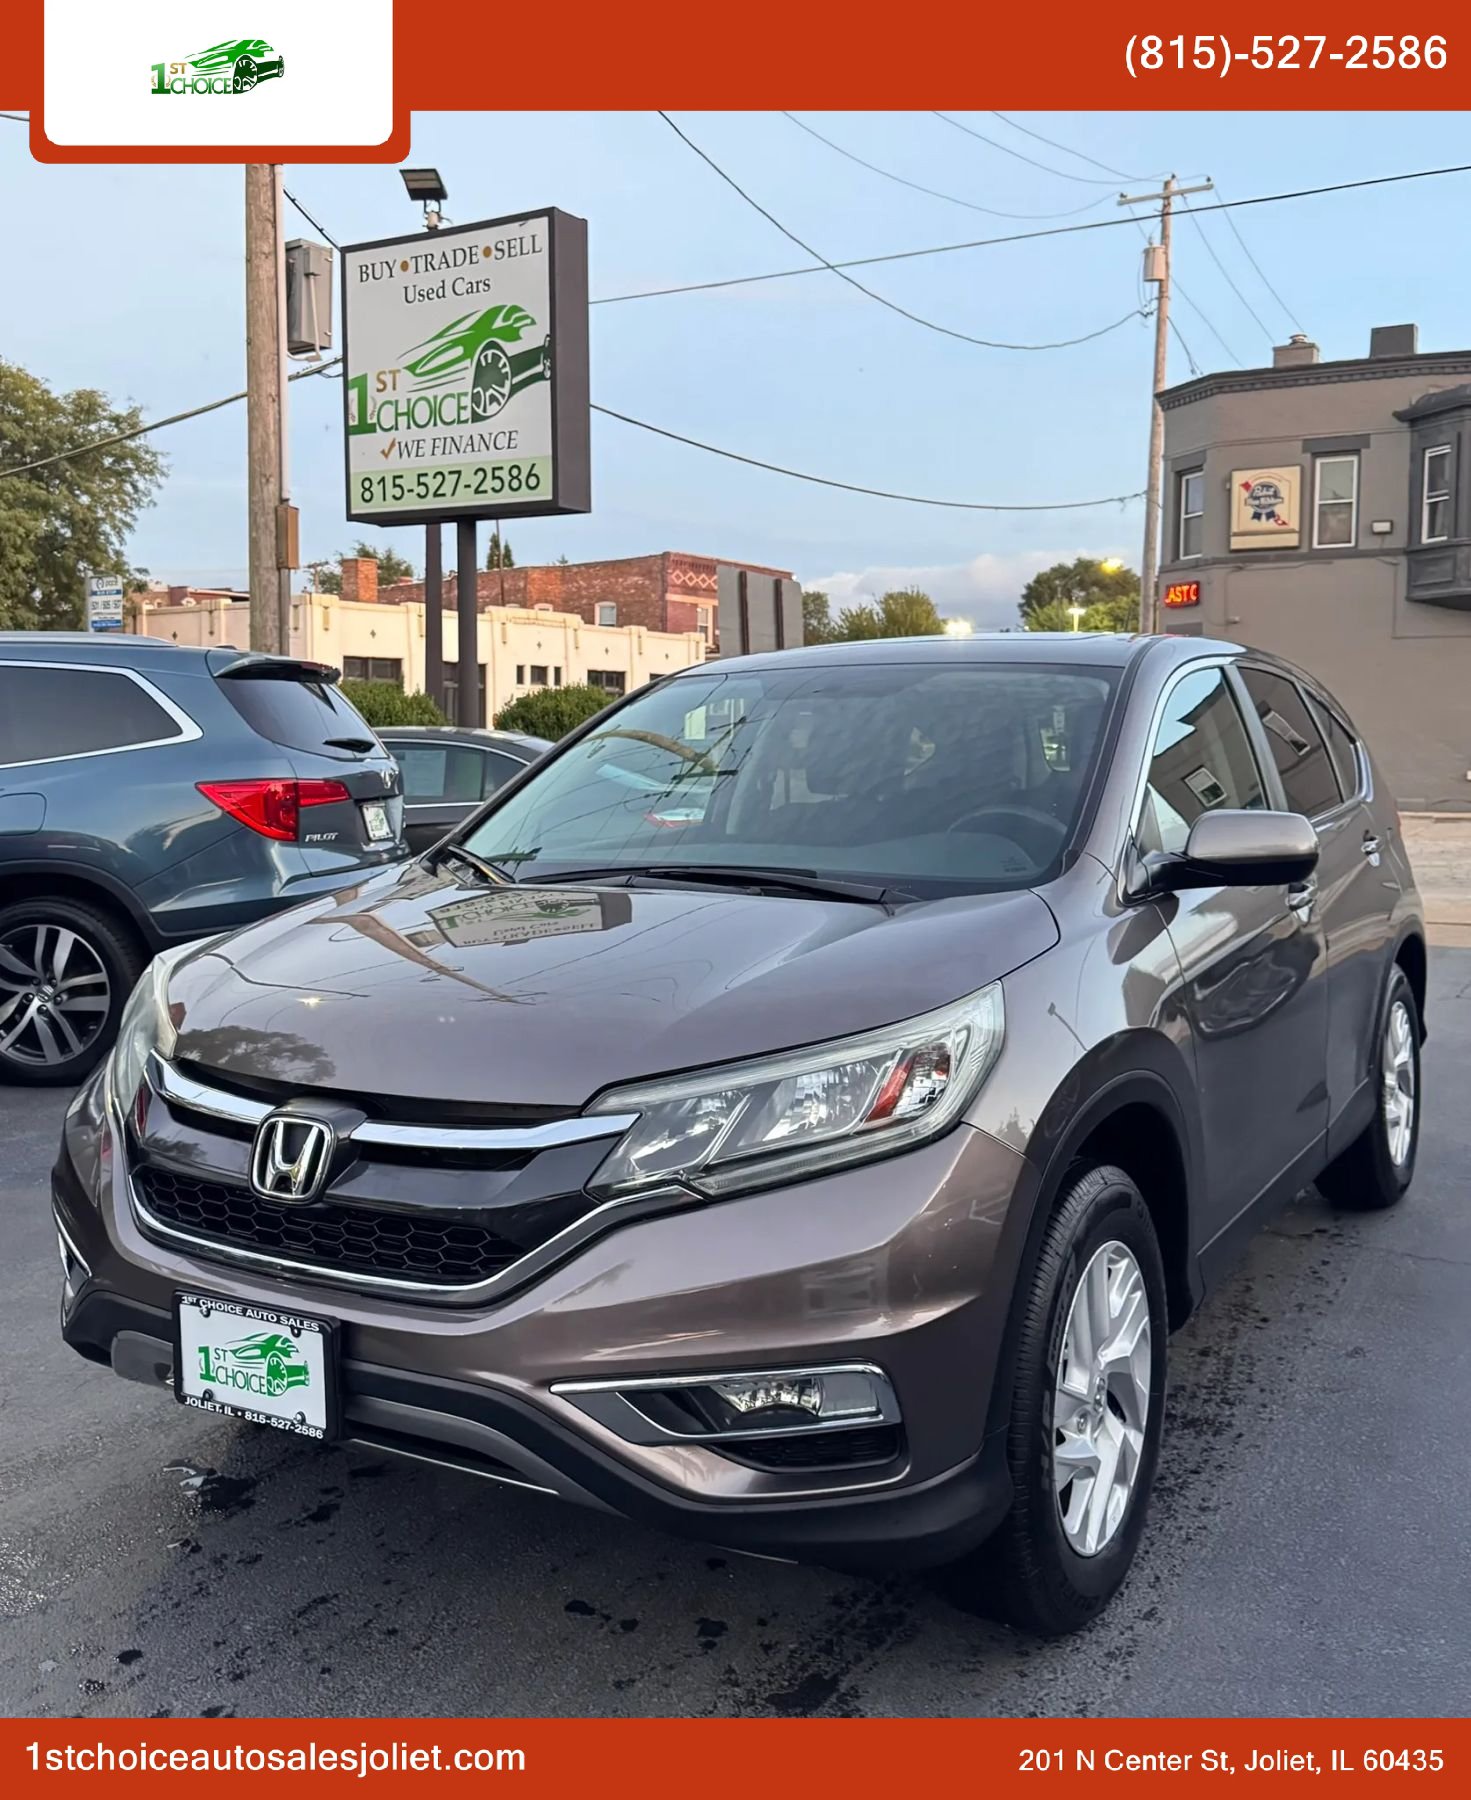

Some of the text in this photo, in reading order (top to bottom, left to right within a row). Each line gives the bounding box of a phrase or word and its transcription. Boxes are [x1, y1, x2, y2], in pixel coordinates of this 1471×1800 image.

[358, 234, 542, 283] BUY TRADE SELL
[403, 277, 491, 304] Used Cars
[376, 391, 470, 433] CHOICE
[397, 430, 518, 460] WE FINANCE
[360, 463, 540, 503] 815-527-2586
[305, 832, 338, 842] PILOT
[182, 1296, 319, 1332] 1ST CHOICE AUTO SALES
[215, 1365, 267, 1395] CHOICE
[184, 1396, 324, 1439] JOLIET, IL 815-527-2586
